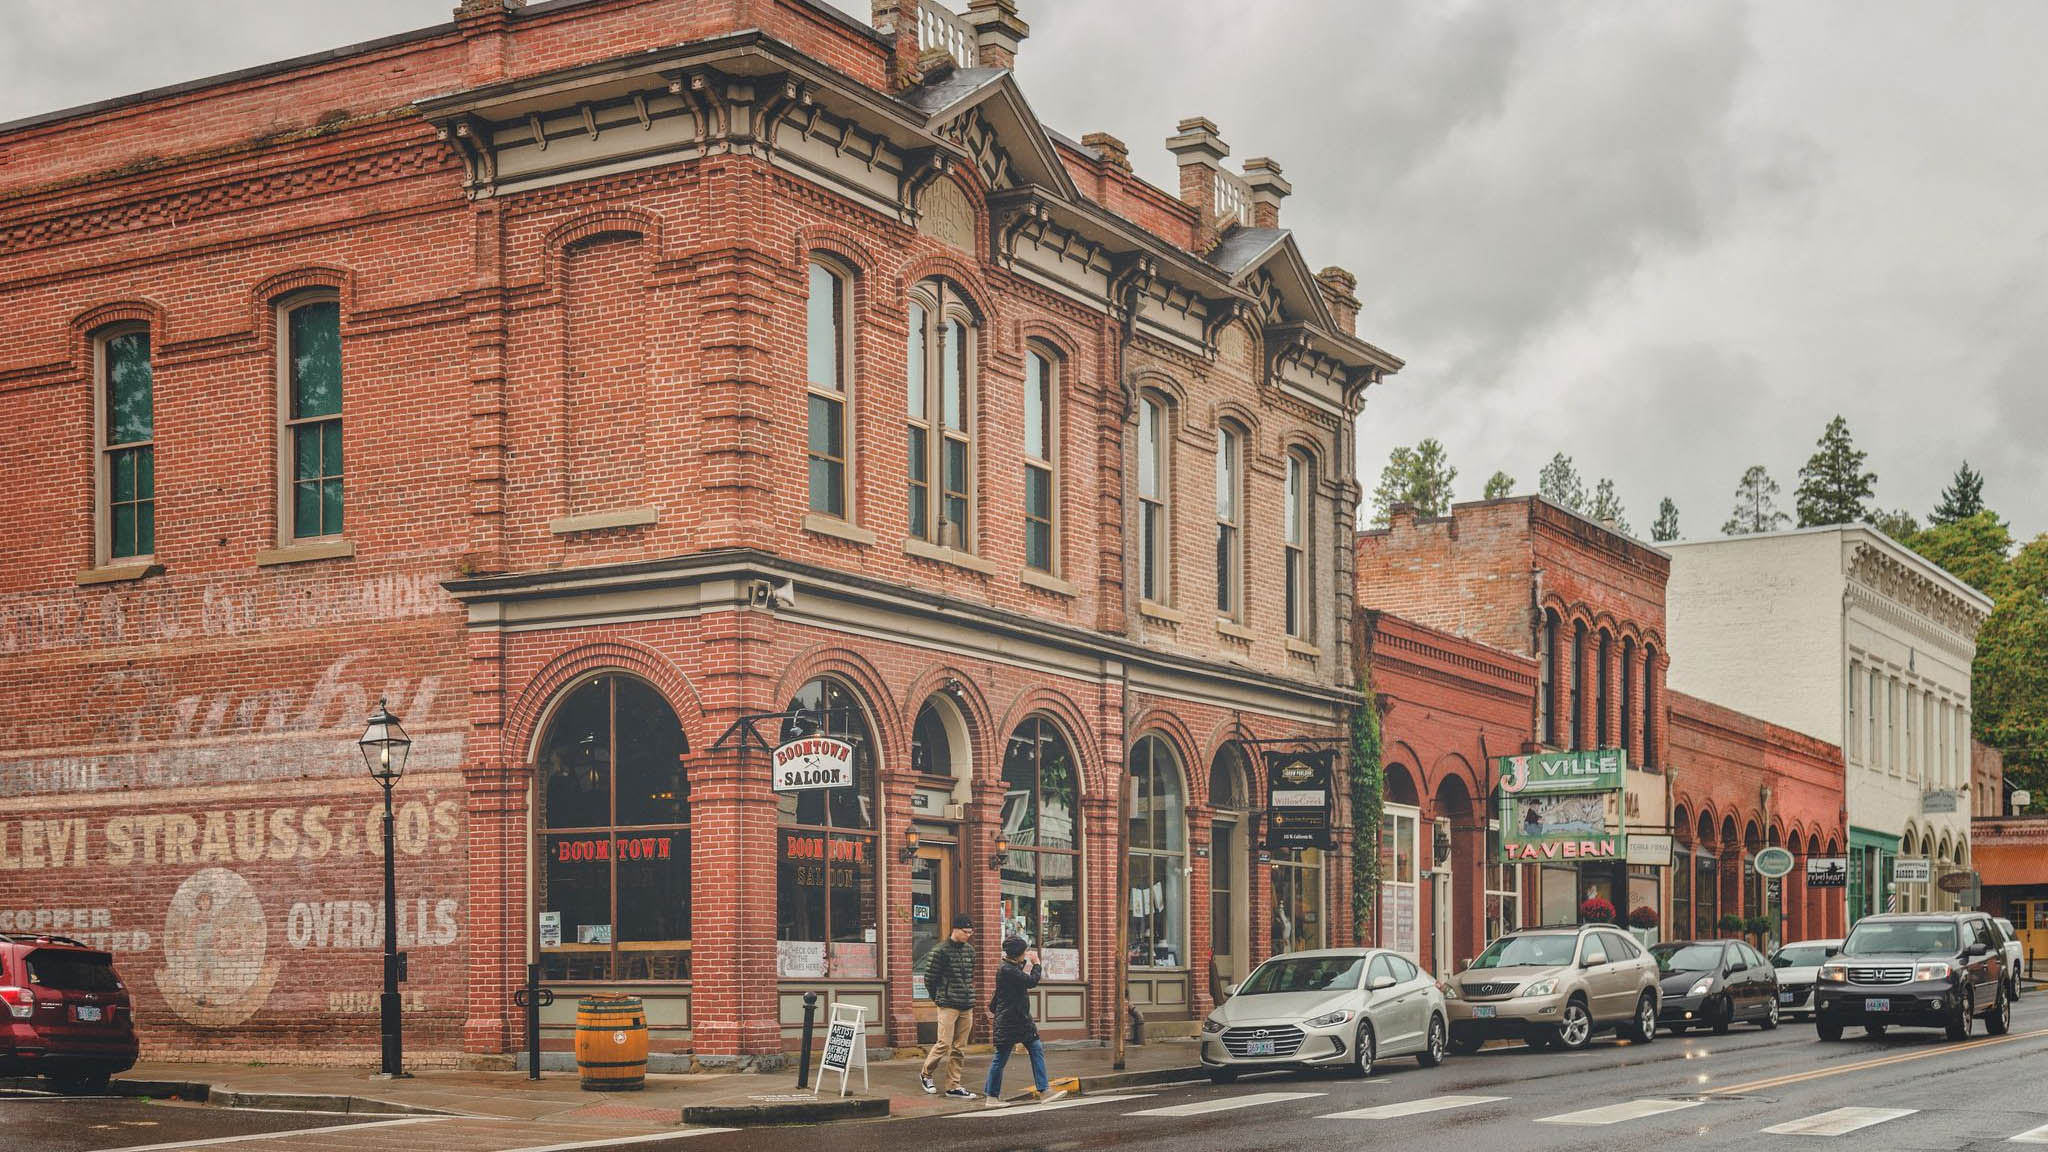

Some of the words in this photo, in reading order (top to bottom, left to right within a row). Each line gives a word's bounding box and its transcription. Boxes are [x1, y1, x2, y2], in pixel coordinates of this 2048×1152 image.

[776, 740, 850, 766] BOOMTOWN
[785, 769, 840, 786] SALOON
[1501, 756, 1531, 792] J
[1540, 756, 1617, 776] VILLE
[1608, 791, 1640, 818] FIMA
[0, 818, 88, 869] LEVI
[104, 806, 334, 866] STRAUSS
[558, 840, 609, 863] BOOM
[615, 837, 671, 860] TOWN
[787, 836, 824, 860] BOOM
[828, 839, 864, 863] TOWN
[1504, 839, 1615, 861] TAVERN
[0, 908, 112, 930] COPPER
[915, 906, 928, 917] OPEN
[330, 991, 425, 1012] DURALE
[832, 1025, 855, 1037] ARTIST
[826, 1052, 847, 1063] GARDEN
